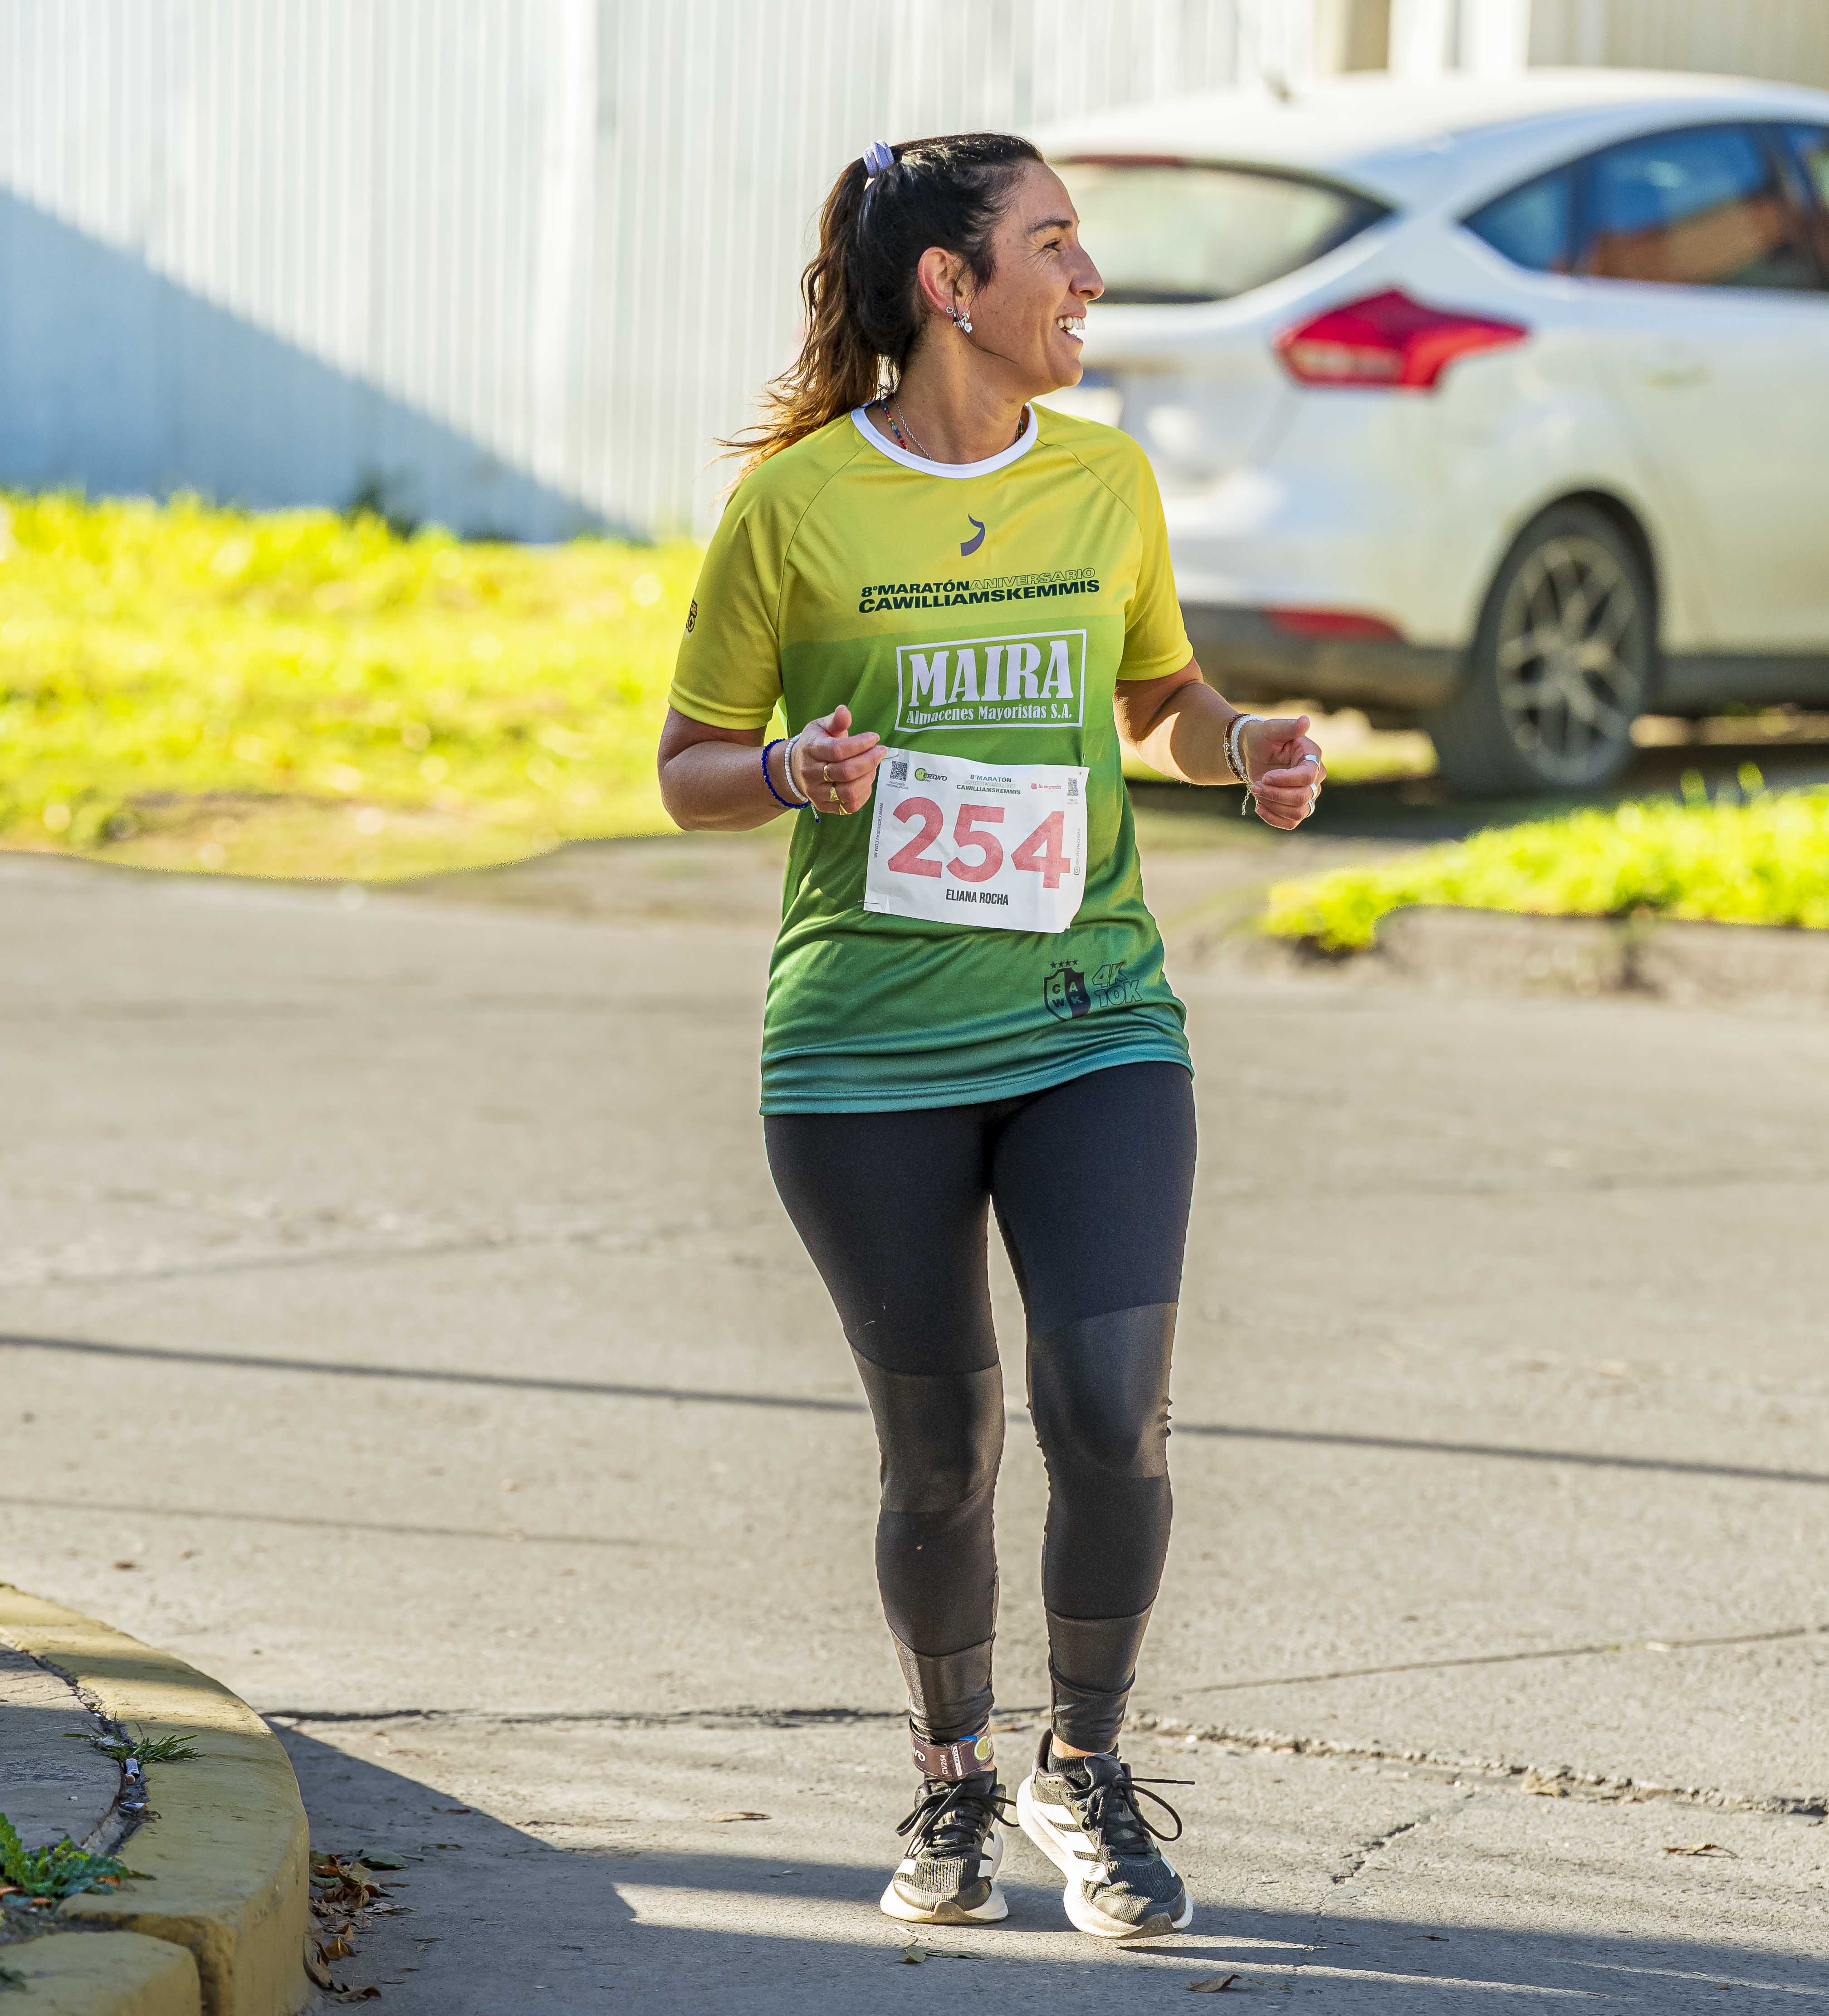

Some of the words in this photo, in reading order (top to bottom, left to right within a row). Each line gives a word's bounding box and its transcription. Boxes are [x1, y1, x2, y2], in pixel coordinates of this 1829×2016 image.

[969, 567, 1095, 591] ANIVERSARIO
[858, 579, 1100, 614] CAWILLIAMSKEMMIS
[908, 640, 1073, 707] MAIRA
[906, 708, 974, 725] Almacenes
[978, 704, 1047, 721] Mayoristas
[1051, 703, 1072, 719] S.A.
[956, 784, 1021, 795] CAWILLIAMSKEMMIS
[887, 797, 1071, 889] 254
[946, 889, 977, 903] ELIANA
[979, 892, 1009, 906] ROCHA
[1092, 962, 1127, 988] 4K
[1094, 980, 1142, 1007] 10K
[940, 1755, 948, 1775] CV254
